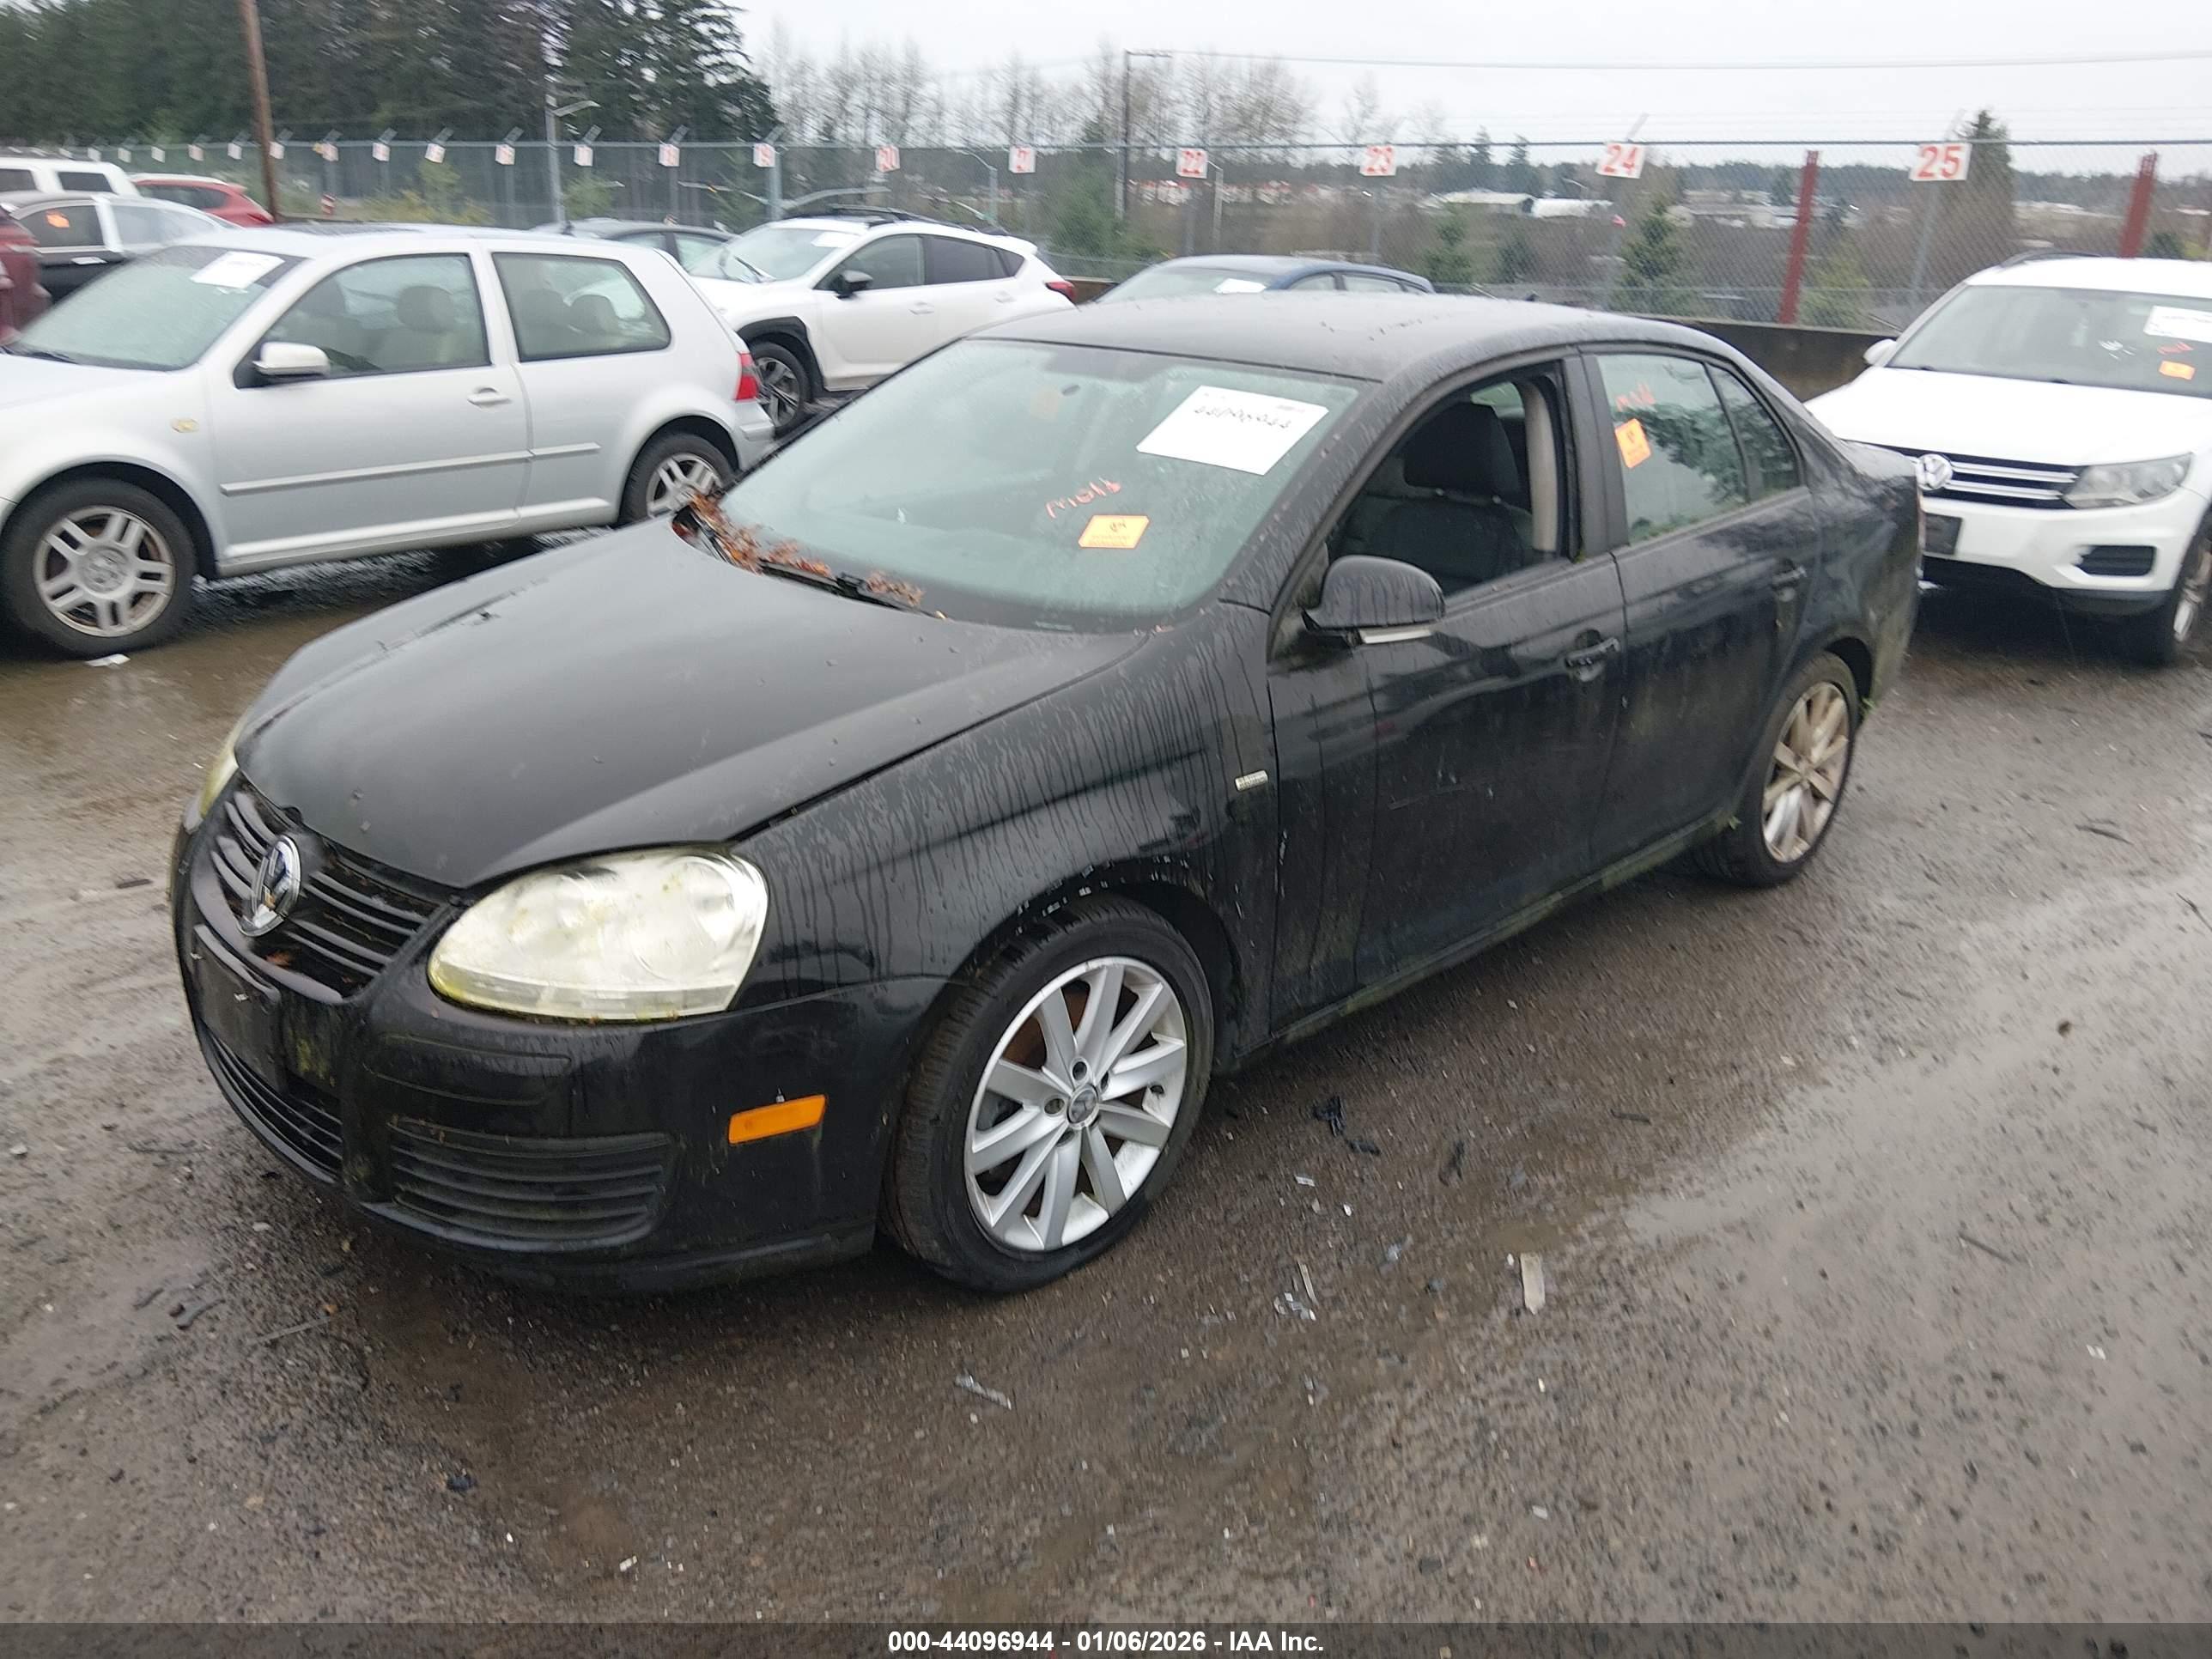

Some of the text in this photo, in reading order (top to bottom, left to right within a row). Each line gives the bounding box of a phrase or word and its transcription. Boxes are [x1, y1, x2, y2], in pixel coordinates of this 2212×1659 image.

[1365, 145, 1393, 174] 23
[1602, 144, 1638, 176] 24
[1917, 144, 1963, 179] 25
